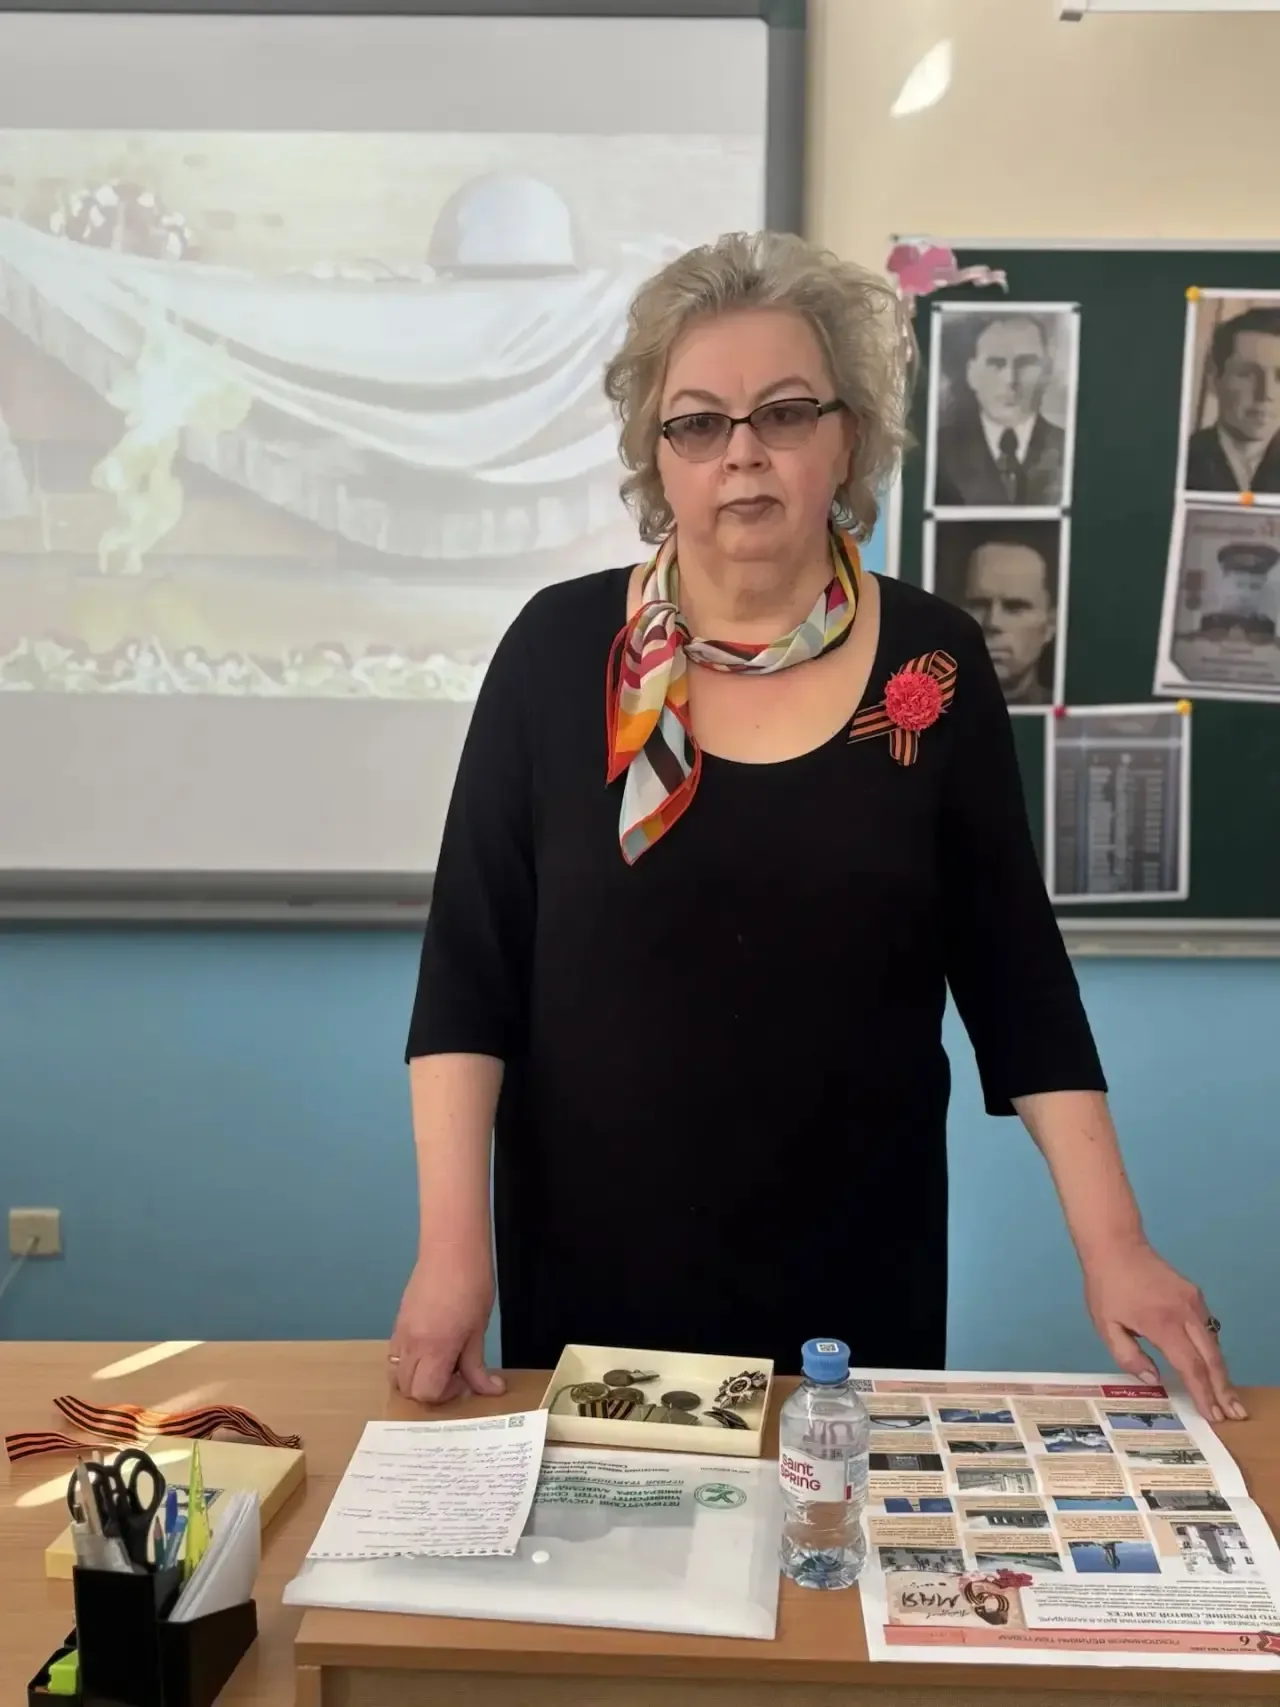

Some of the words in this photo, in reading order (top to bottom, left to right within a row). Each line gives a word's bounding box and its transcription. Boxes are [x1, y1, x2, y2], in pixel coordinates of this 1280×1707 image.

[781, 1464, 821, 1491] SPRING
[545, 1485, 611, 1493] АЛЕКСАНДРА
[600, 1500, 680, 1508] ПЕТЕРБУРГСКИЙ
[902, 1592, 960, 1608] МАЯ
[1239, 1636, 1250, 1646] 6
